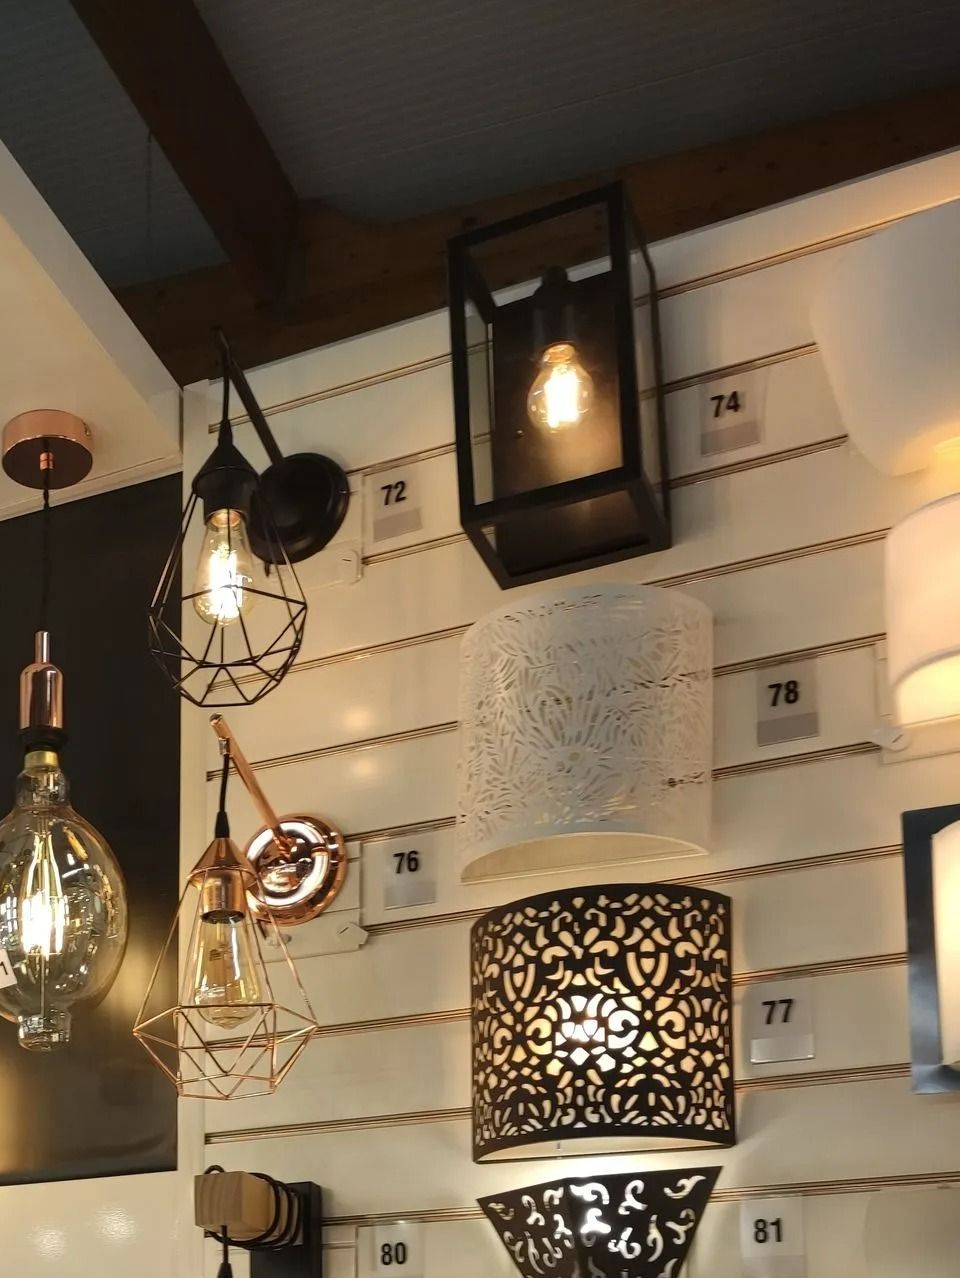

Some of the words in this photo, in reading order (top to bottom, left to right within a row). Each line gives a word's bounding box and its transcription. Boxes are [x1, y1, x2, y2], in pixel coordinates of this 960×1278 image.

[710, 391, 741, 417] 74
[380, 481, 407, 506] 72
[768, 680, 800, 706] 78
[394, 851, 420, 875] 76
[763, 999, 794, 1025] 77
[753, 1218, 784, 1243] 81
[380, 1241, 407, 1266] 80
